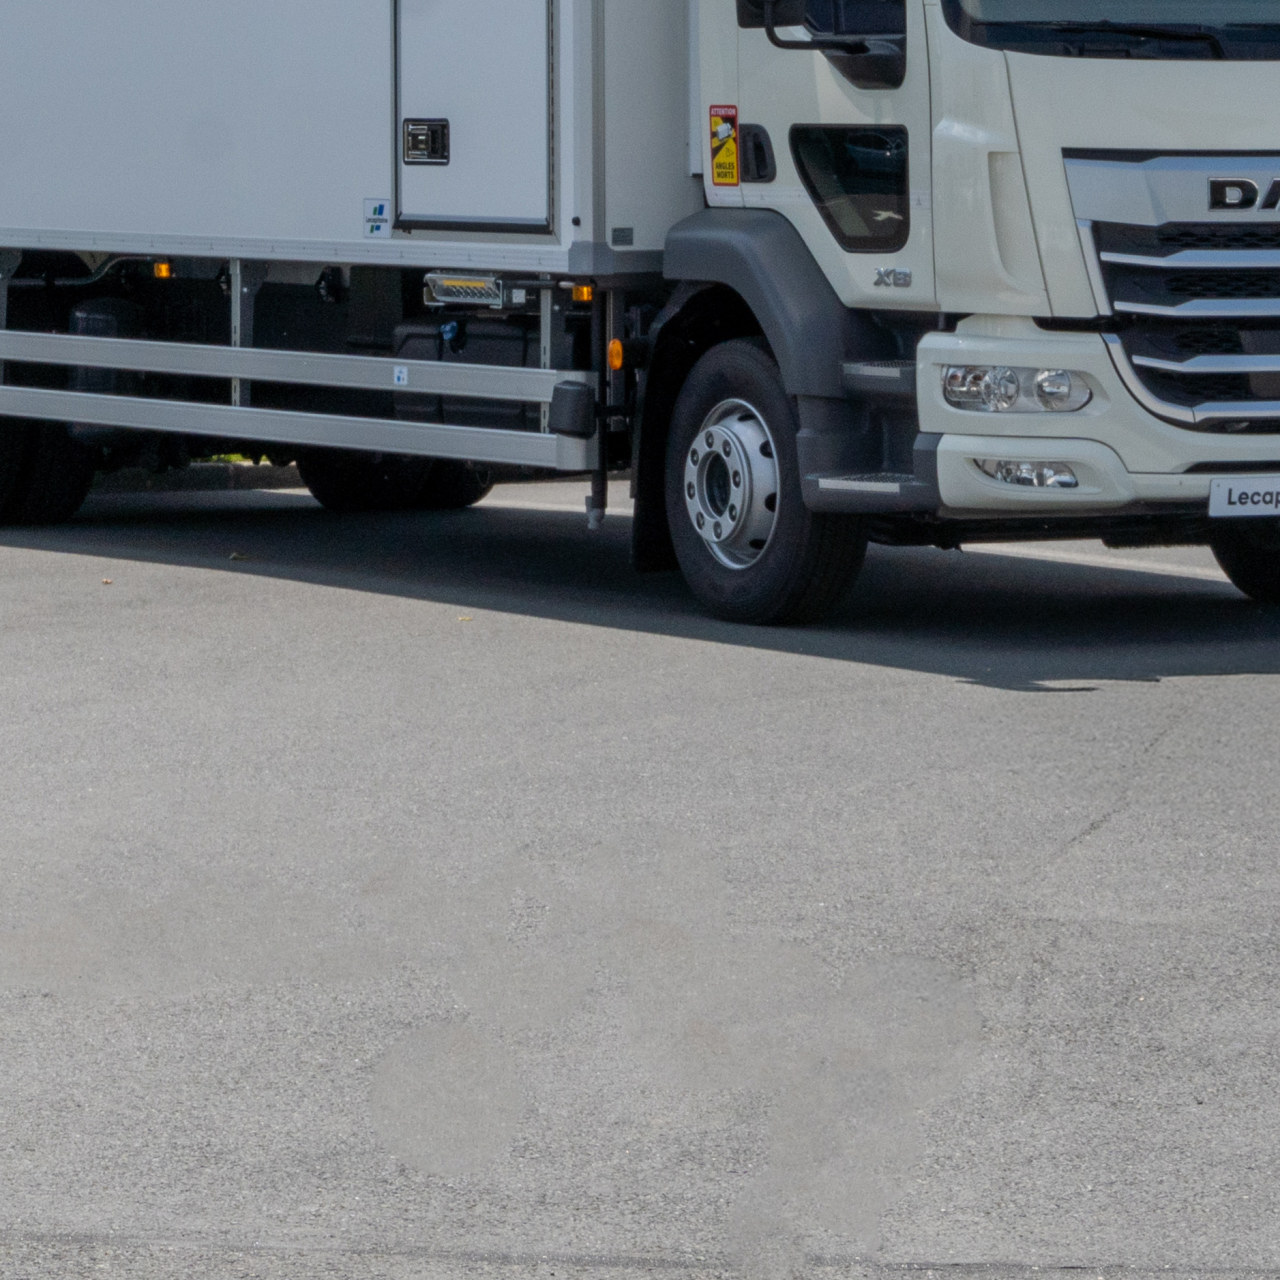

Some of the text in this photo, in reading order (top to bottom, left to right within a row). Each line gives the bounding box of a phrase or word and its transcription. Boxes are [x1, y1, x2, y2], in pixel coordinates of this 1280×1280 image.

[711, 107, 736, 116] ATTENTION
[715, 162, 735, 170] ANGLES
[716, 171, 734, 179] MORTS
